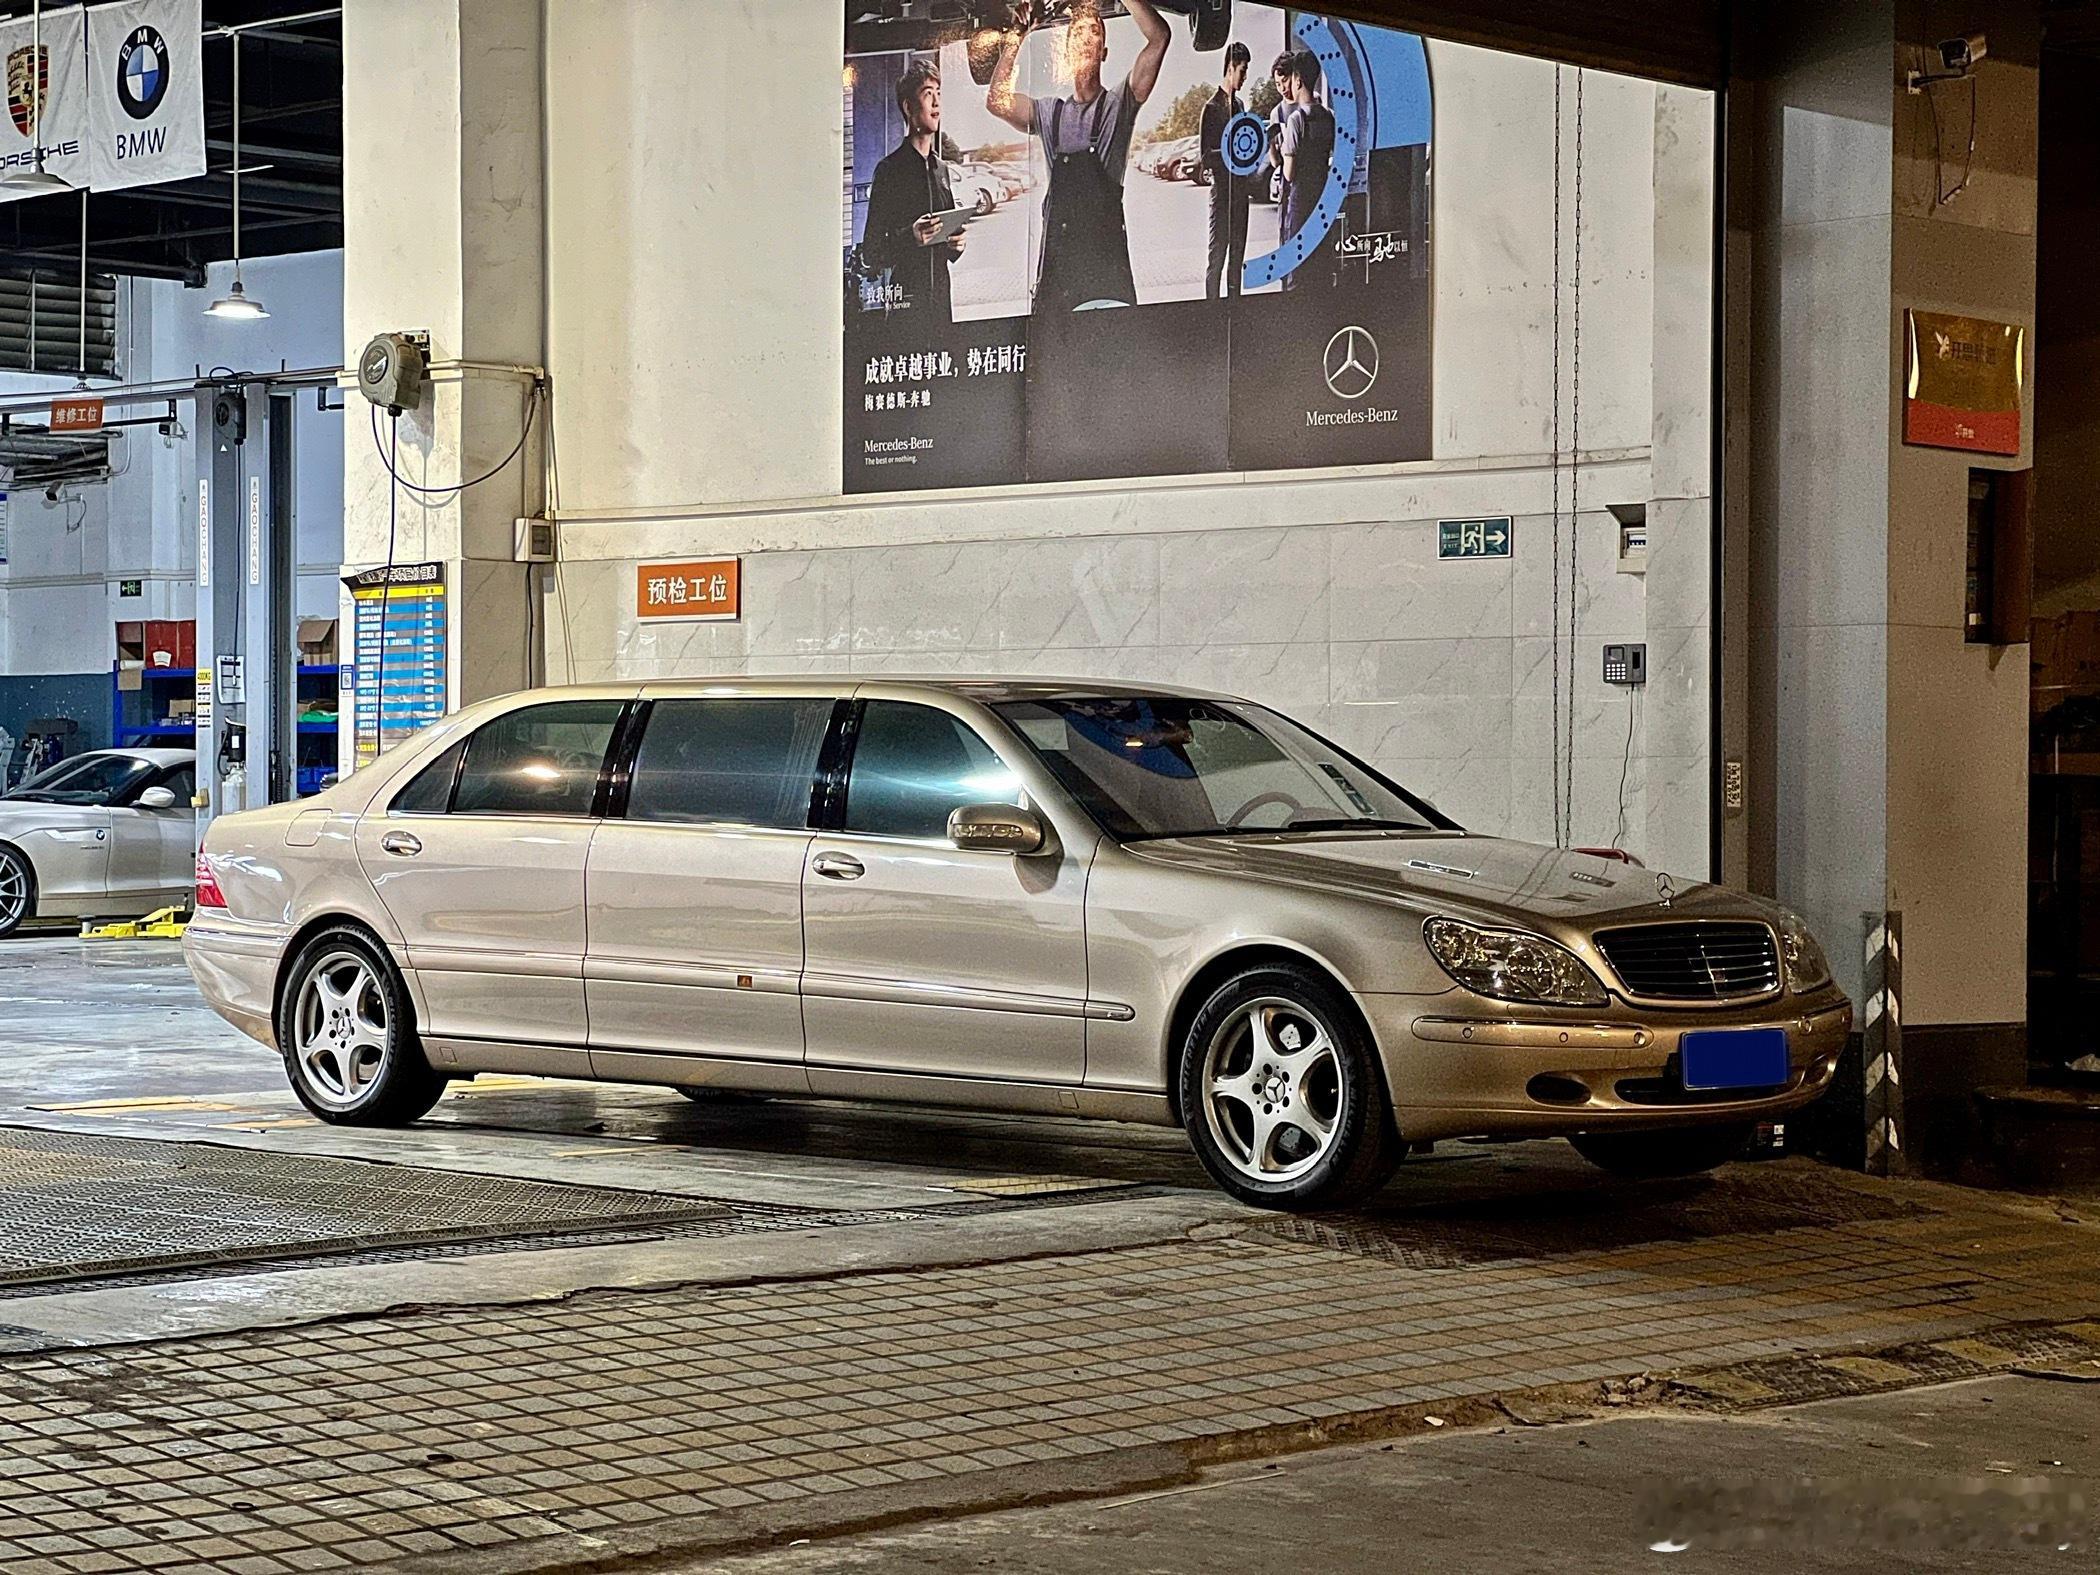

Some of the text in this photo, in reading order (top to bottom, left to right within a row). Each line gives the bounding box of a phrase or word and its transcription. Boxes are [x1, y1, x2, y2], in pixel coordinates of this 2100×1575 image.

[122, 29, 164, 60] BMW
[117, 127, 166, 160] BMW
[893, 301, 911, 310] Service
[865, 344, 1027, 385] 成就卓越事业，势在同行
[864, 389, 931, 412] 梅赛德斯-奔驰
[56, 406, 97, 424] 维修工位
[1306, 407, 1398, 426] Mercedes-Benz
[864, 436, 933, 453] Mercedes-Benz
[865, 457, 875, 466] The
[876, 456, 888, 465] best
[647, 574, 728, 605] 预检工位
